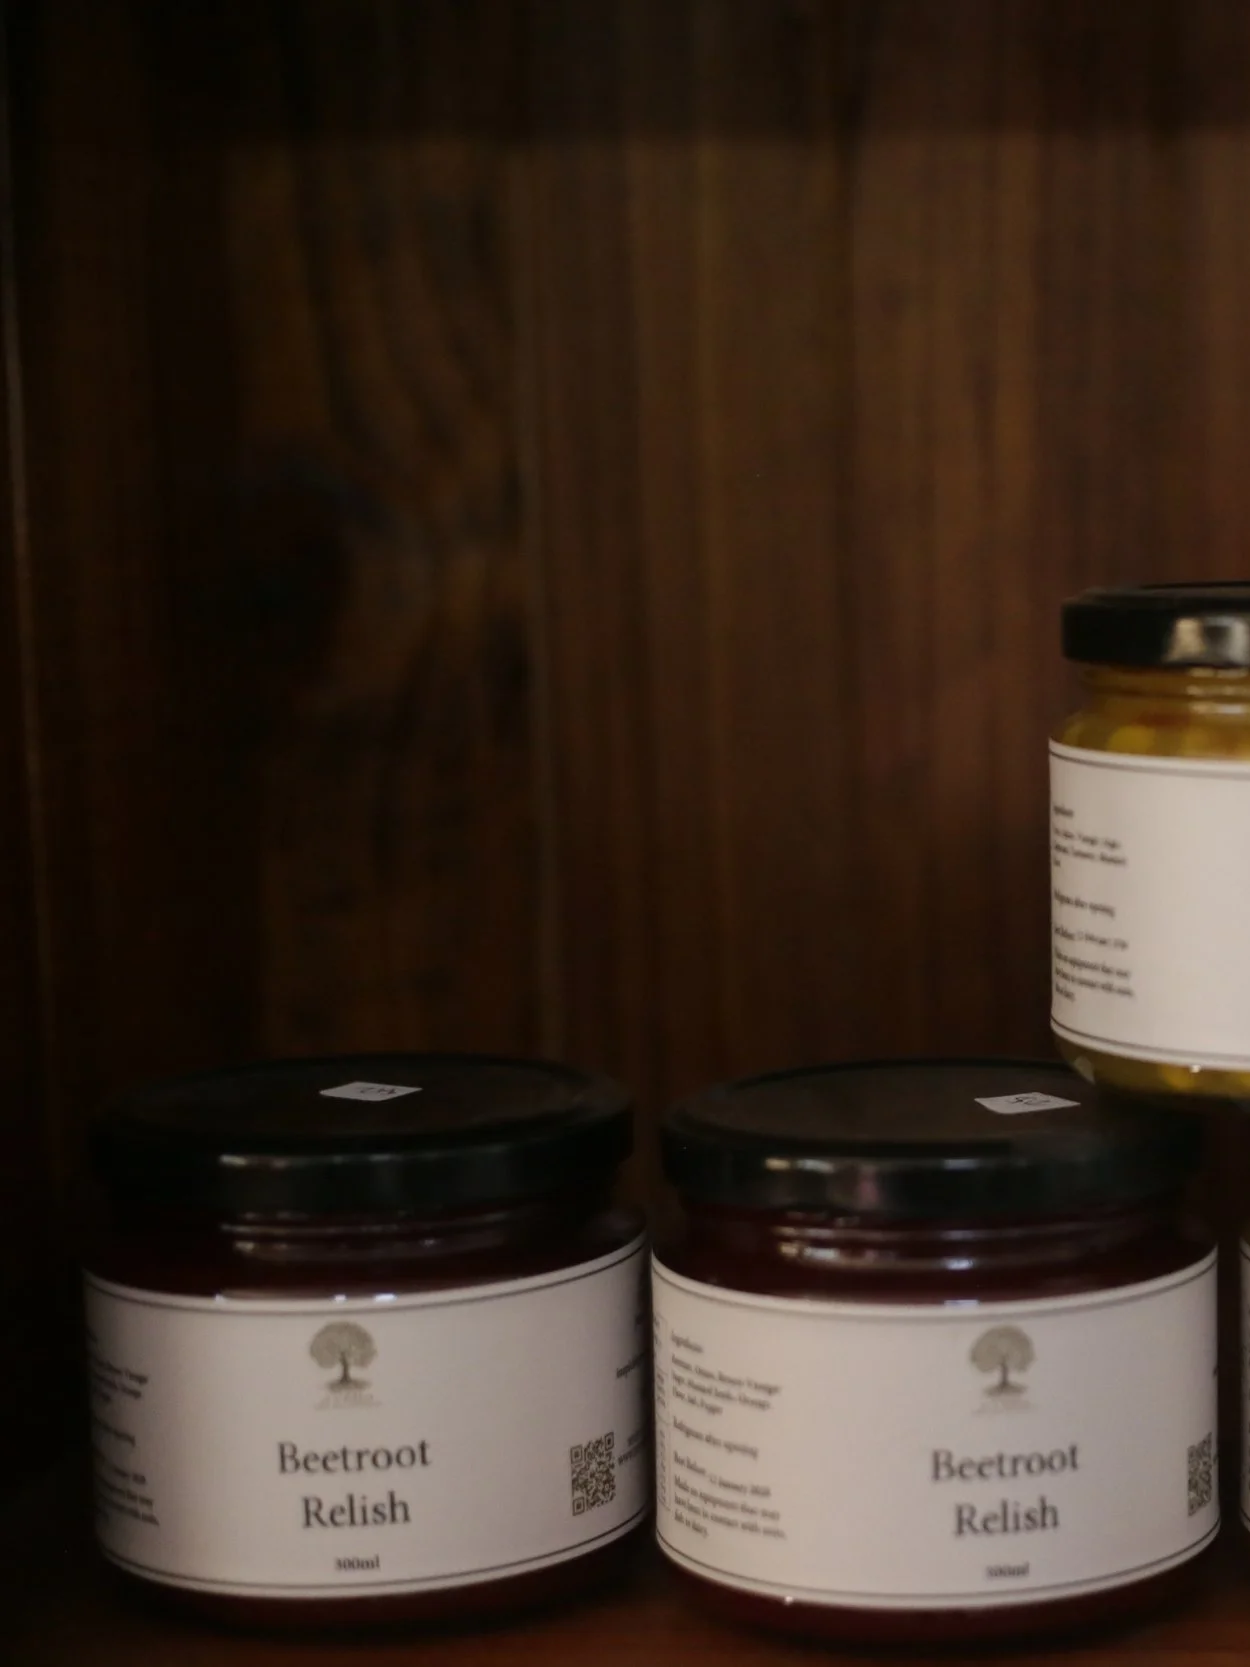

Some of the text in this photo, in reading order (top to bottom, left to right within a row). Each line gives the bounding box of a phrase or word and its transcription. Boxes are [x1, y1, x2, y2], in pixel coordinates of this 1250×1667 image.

[278, 1439, 431, 1475] Beetroot
[931, 1443, 1080, 1482] Beetroot
[302, 1491, 411, 1528] Relish
[954, 1495, 1060, 1535] Relish
